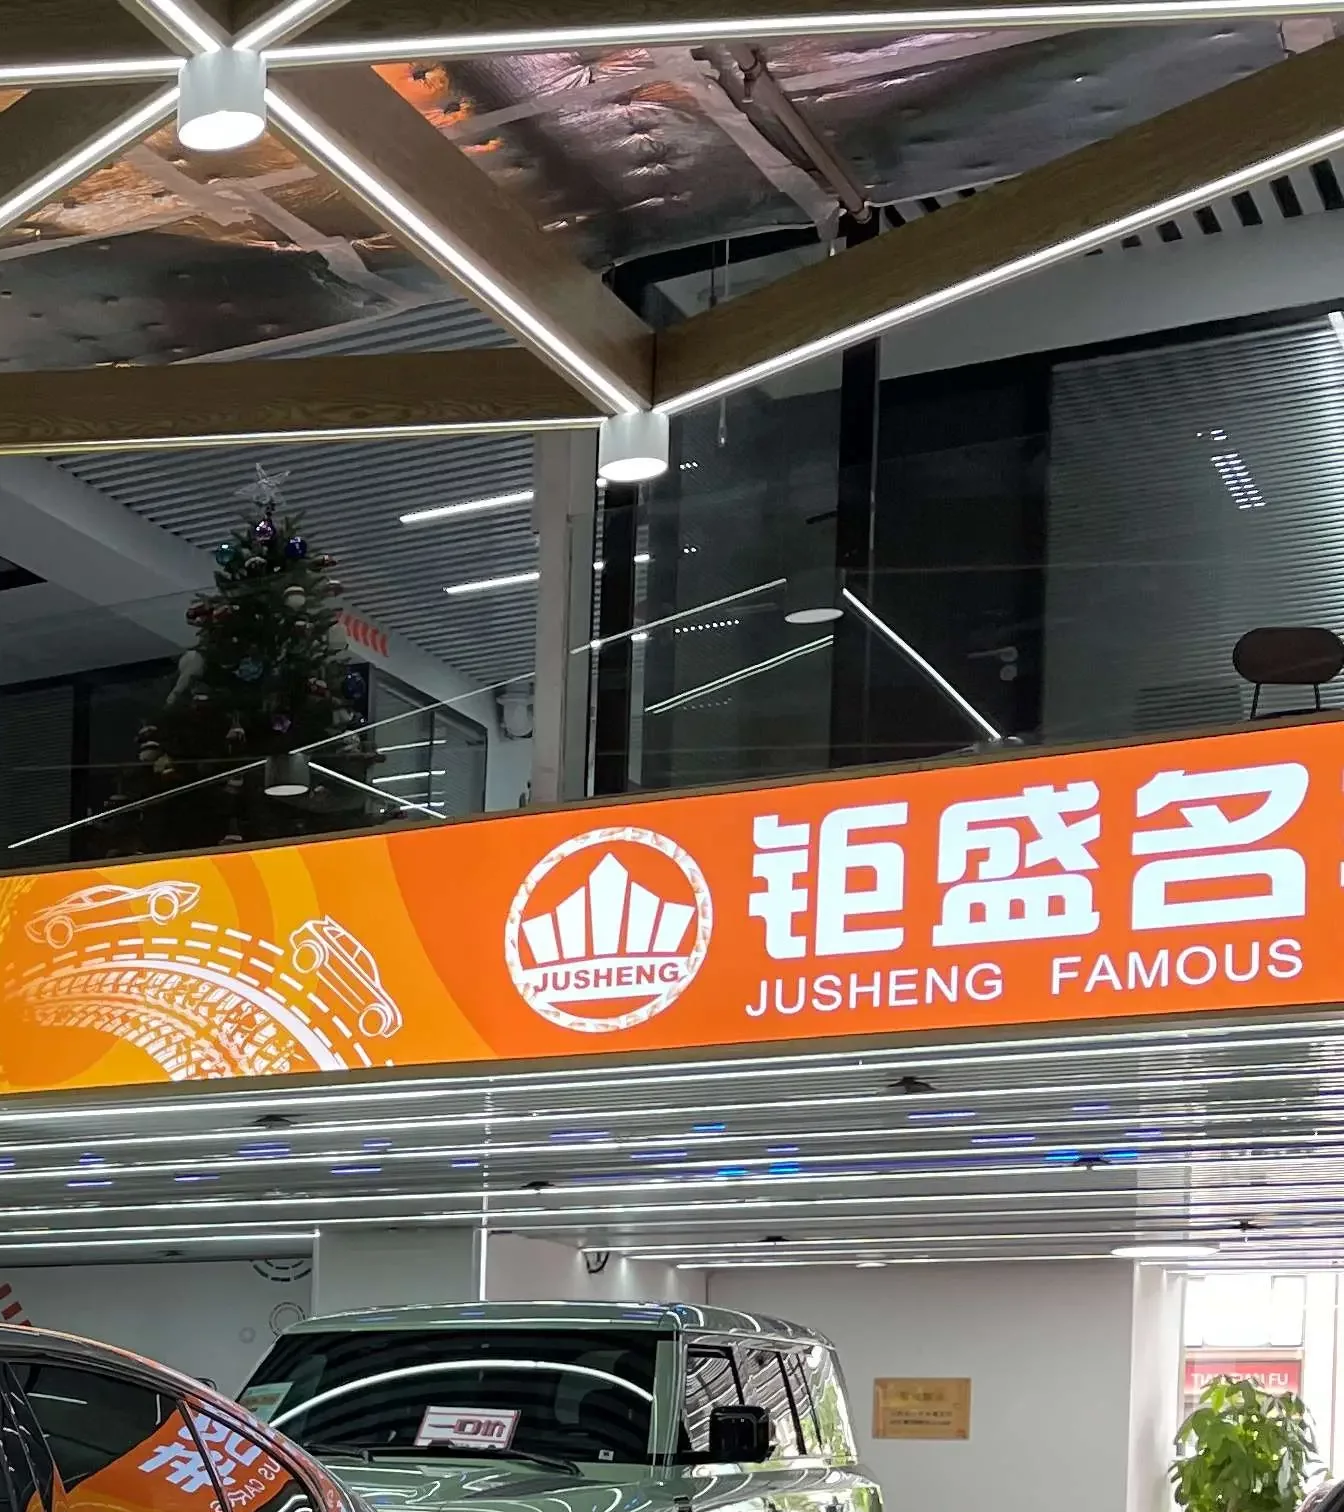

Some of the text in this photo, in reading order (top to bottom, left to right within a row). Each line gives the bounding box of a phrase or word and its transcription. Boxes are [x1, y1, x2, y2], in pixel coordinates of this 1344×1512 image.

[749, 762, 1344, 960] 钜盛名
[534, 962, 679, 993] JUSHENG
[745, 938, 1304, 1017] JUSHENG FAMOUS
